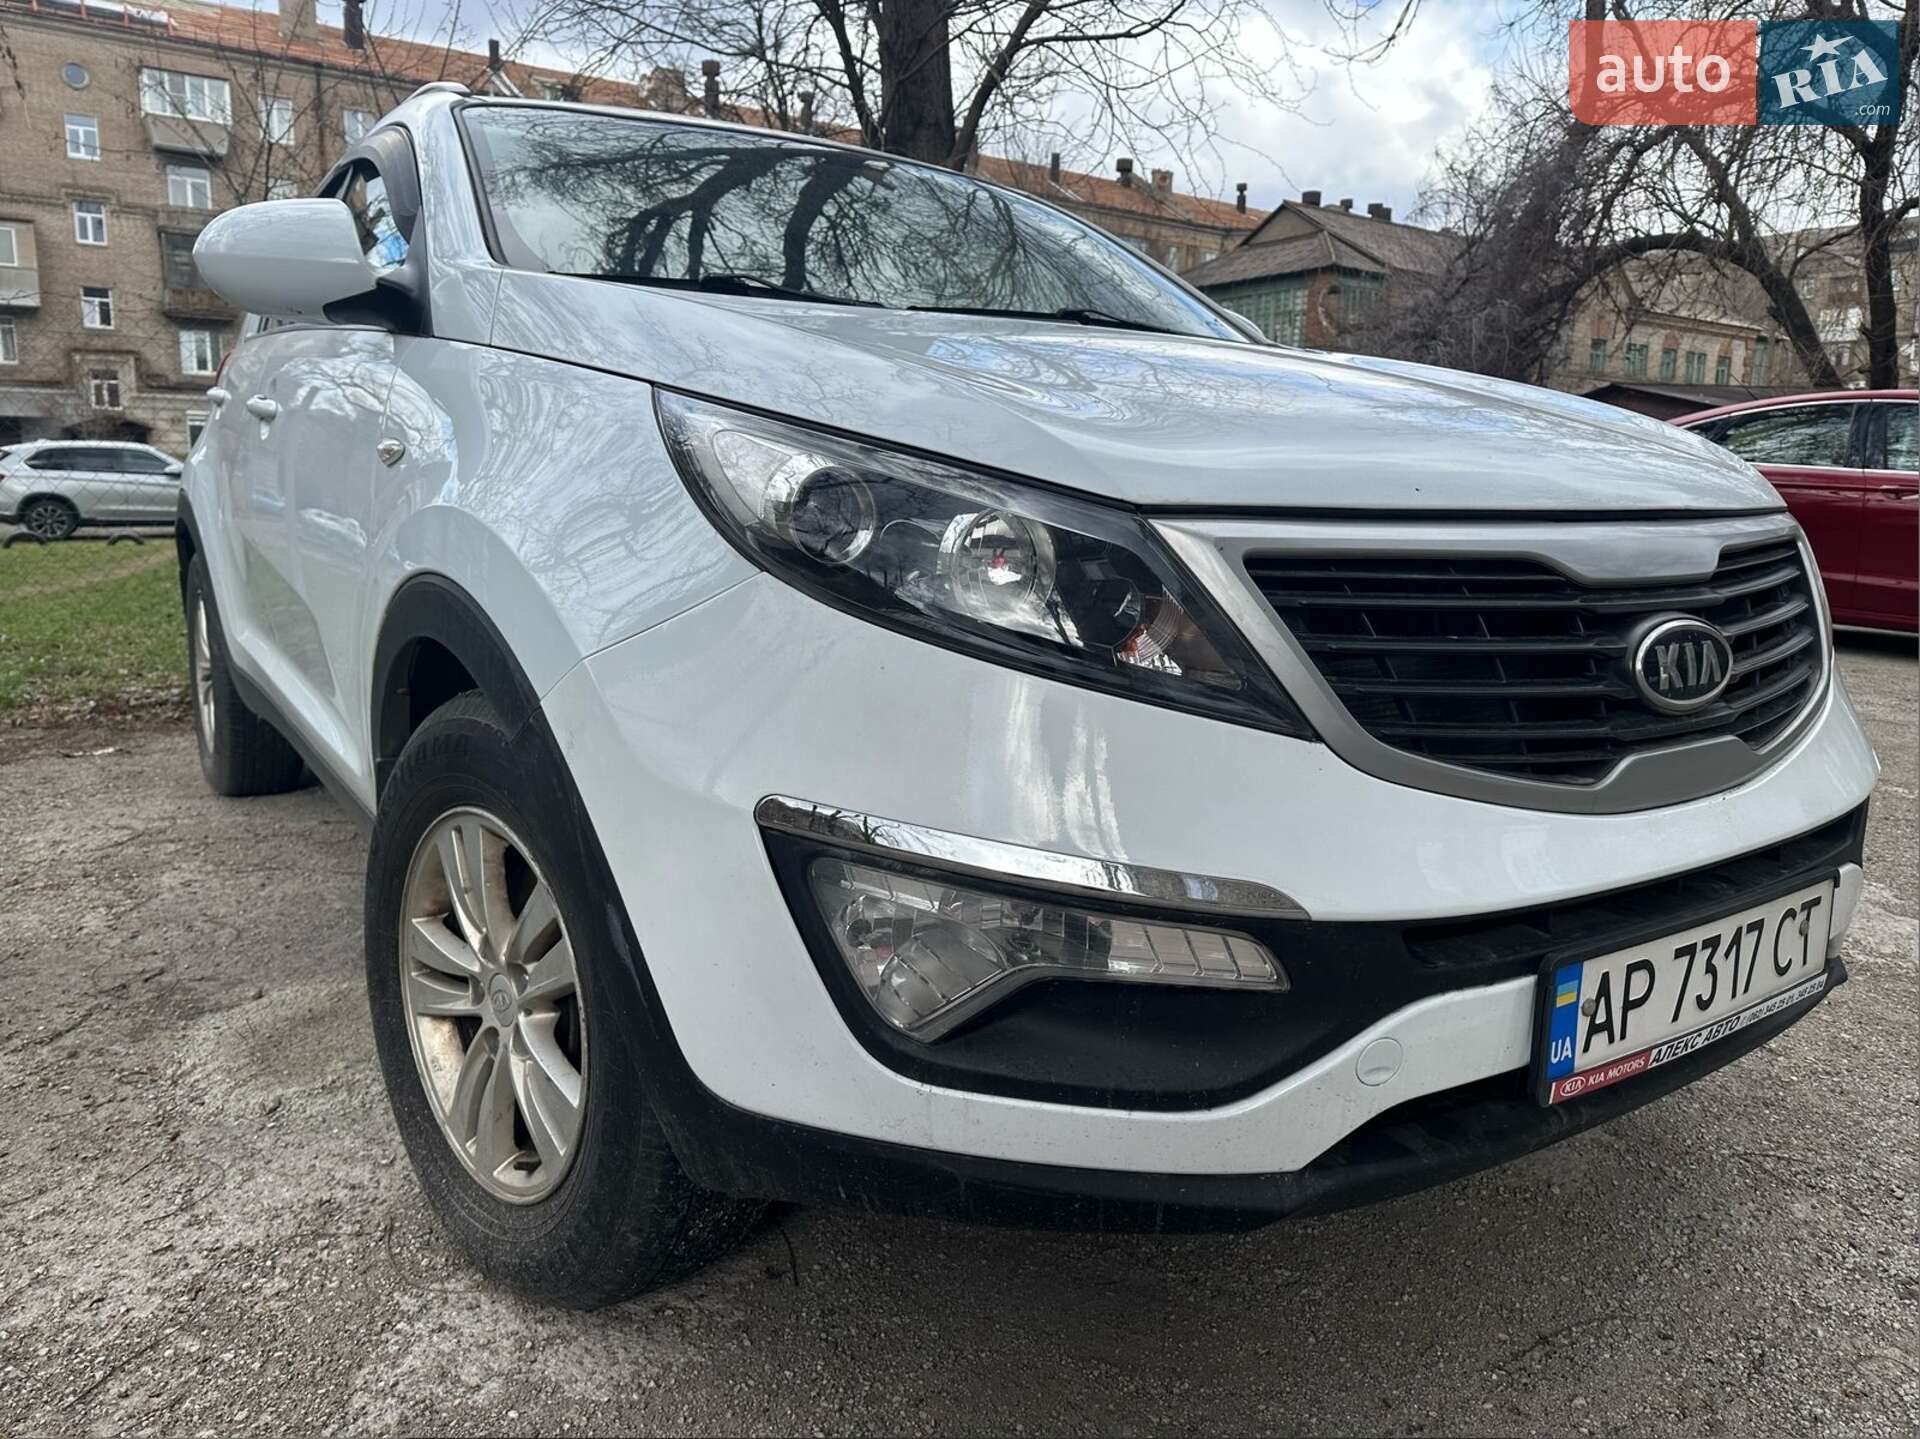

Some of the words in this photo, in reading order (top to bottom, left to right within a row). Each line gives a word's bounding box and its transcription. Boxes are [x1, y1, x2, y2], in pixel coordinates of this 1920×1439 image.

[1655, 640, 1722, 690] KIA
[1582, 958, 1656, 1053] AP
[1671, 918, 1765, 1023] 7317
[1772, 896, 1822, 977] CT
[1551, 1040, 1572, 1064] UA
[1651, 1033, 1702, 1066] АЛЕКС
[1564, 1080, 1583, 1094] KIA
[1587, 1073, 1605, 1087] KIA
[1606, 1057, 1645, 1079] MOTORS
